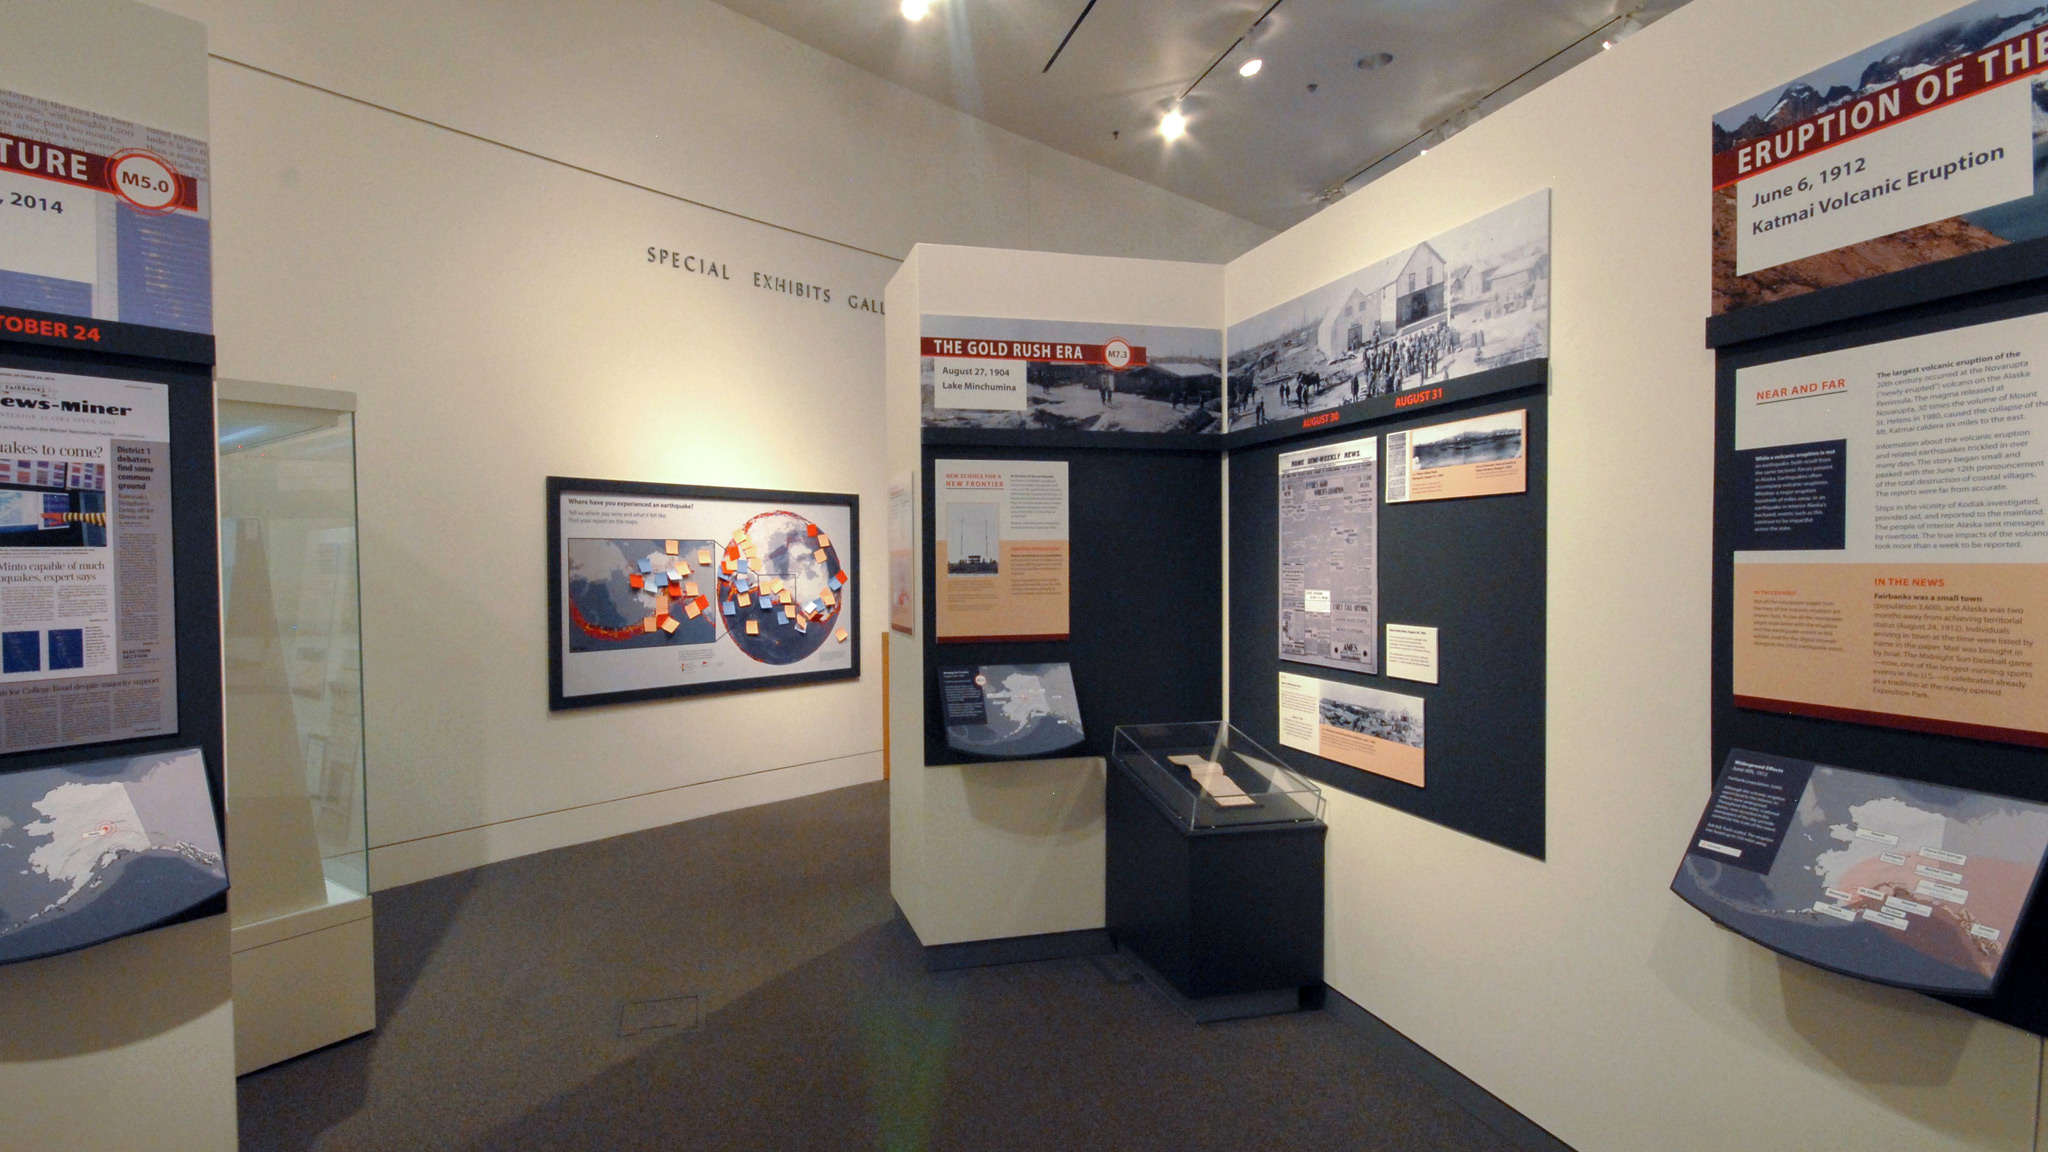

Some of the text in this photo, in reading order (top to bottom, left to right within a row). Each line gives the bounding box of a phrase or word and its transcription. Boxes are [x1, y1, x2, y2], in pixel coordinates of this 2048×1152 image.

[1738, 29, 2048, 175] ERUPTION OF THE
[0, 136, 169, 193] TURE M5.0
[1751, 157, 1866, 209] June 6, 1912
[1752, 146, 2005, 236] Katmai Volcanic Eruption
[10, 192, 64, 214] 2014
[647, 246, 886, 315] SPECIAL EXHIBITS GALL
[74, 325, 101, 342] 24
[933, 339, 1083, 360] THE GOLD RUSH ERA
[1108, 350, 1127, 359] M7.3
[942, 366, 1010, 377] August 27, 1904
[1892, 366, 1919, 376] largest
[1921, 362, 1953, 372] volcanic
[1955, 356, 1992, 366] eruption
[942, 382, 1017, 391] Lake Minchumina
[1756, 378, 1846, 400] NEAR AND FAR
[1394, 387, 1443, 408] AUGUST 31
[1302, 411, 1340, 428] AUGUST 30
[42, 443, 55, 455] to
[60, 446, 103, 459] come?
[117, 446, 143, 455] District
[117, 455, 152, 464] debaters
[117, 464, 133, 472] find
[118, 482, 146, 490] ground
[617, 501, 652, 509] experienced
[660, 502, 694, 510] earthquake?
[29, 562, 66, 573] capable
[68, 562, 78, 570] of
[79, 561, 105, 570] much
[44, 574, 74, 584] expert
[76, 575, 97, 583] says
[1874, 577, 1944, 586] IN THE NEWS
